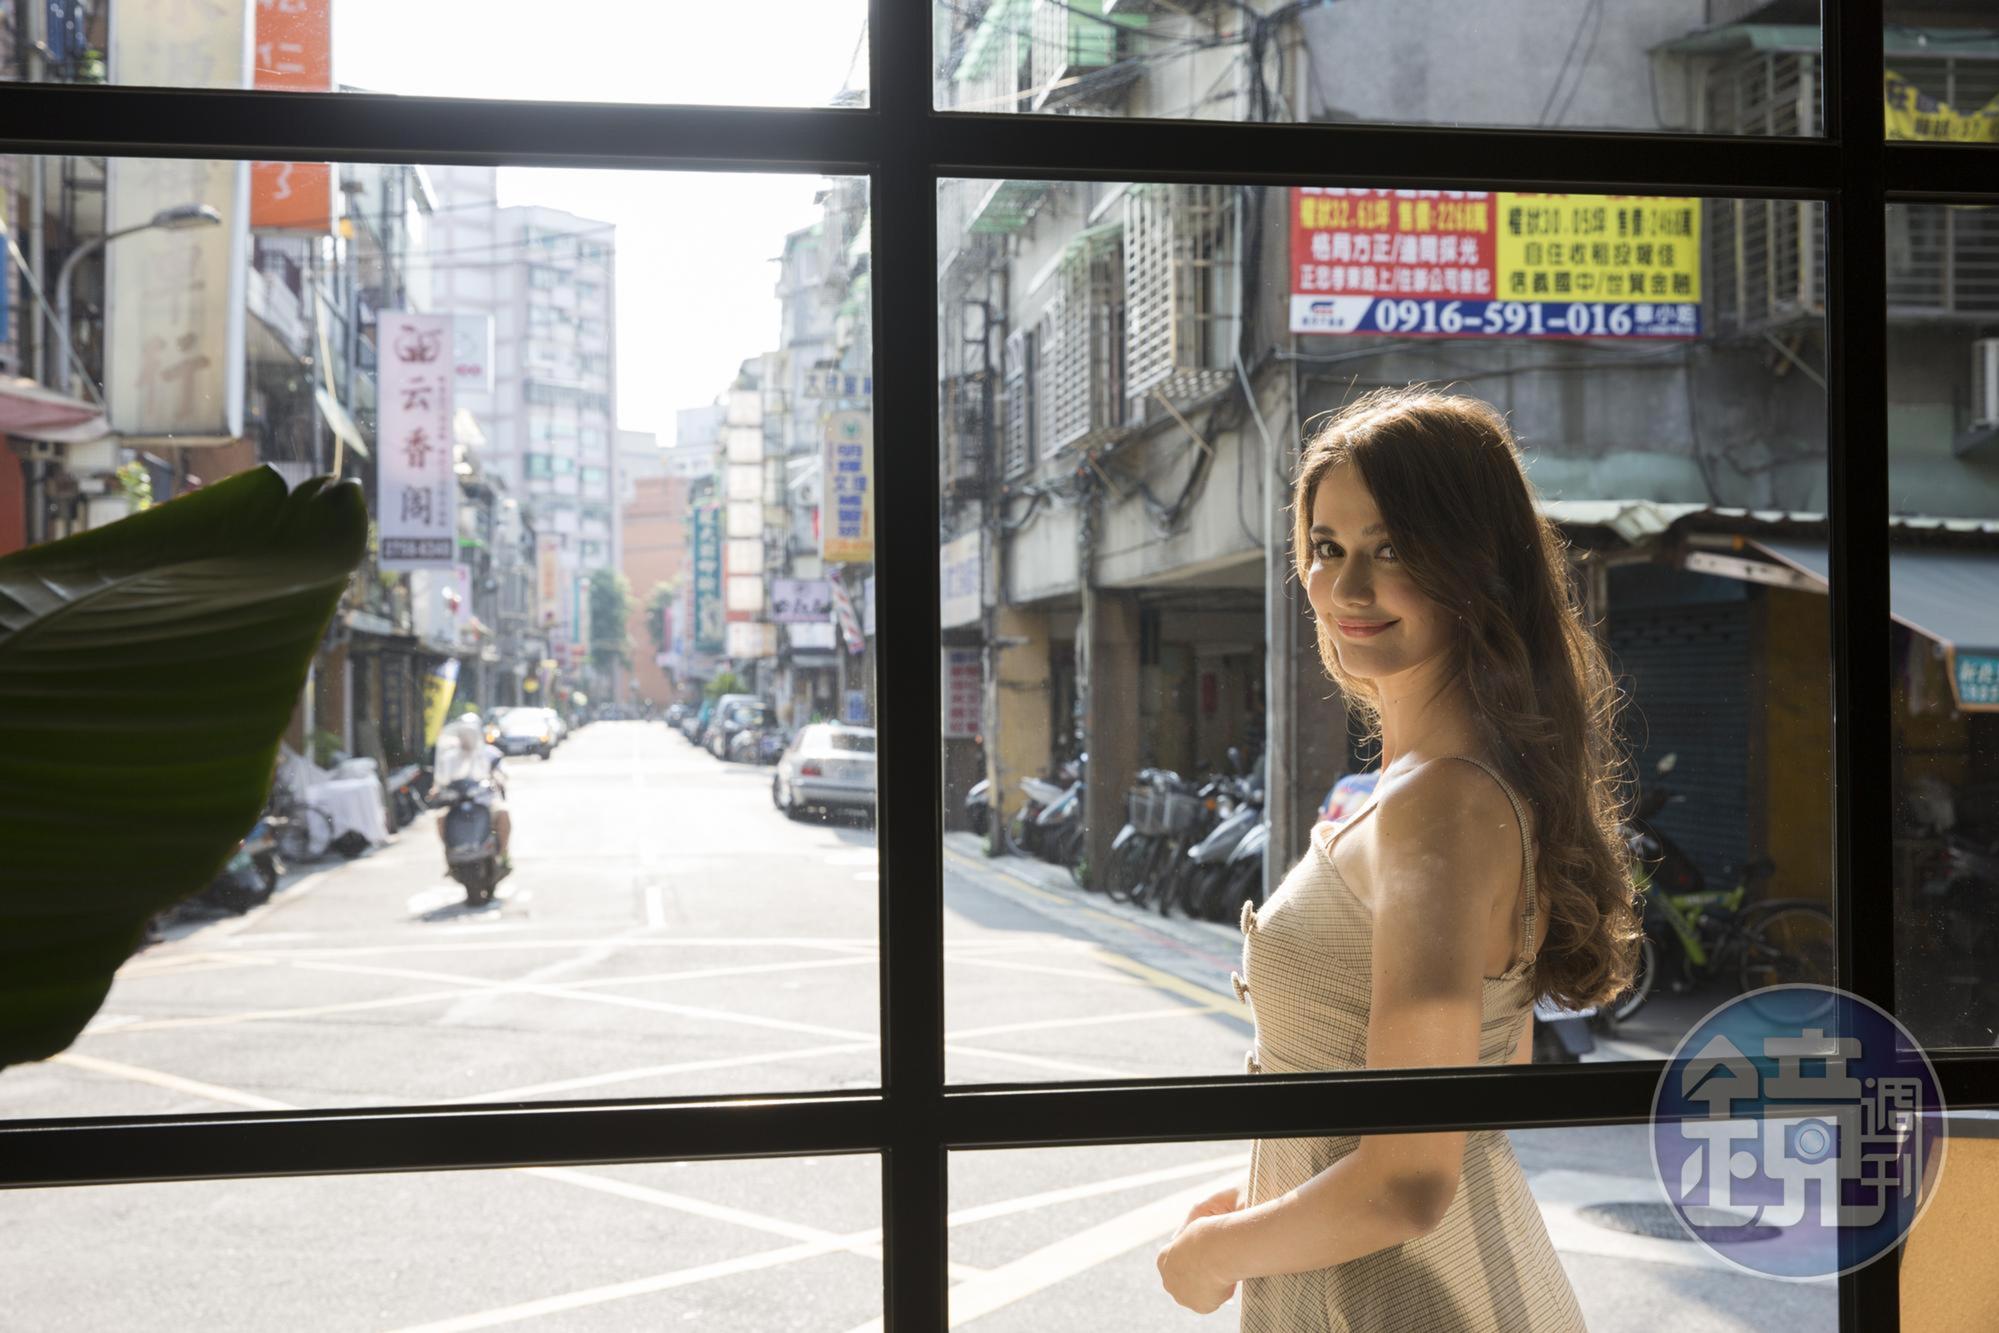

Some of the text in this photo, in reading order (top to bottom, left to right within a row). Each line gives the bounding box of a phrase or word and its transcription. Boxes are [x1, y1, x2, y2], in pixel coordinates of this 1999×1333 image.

[1375, 299, 1632, 335] 0916-591-016
[400, 376, 434, 526] 云香閣
